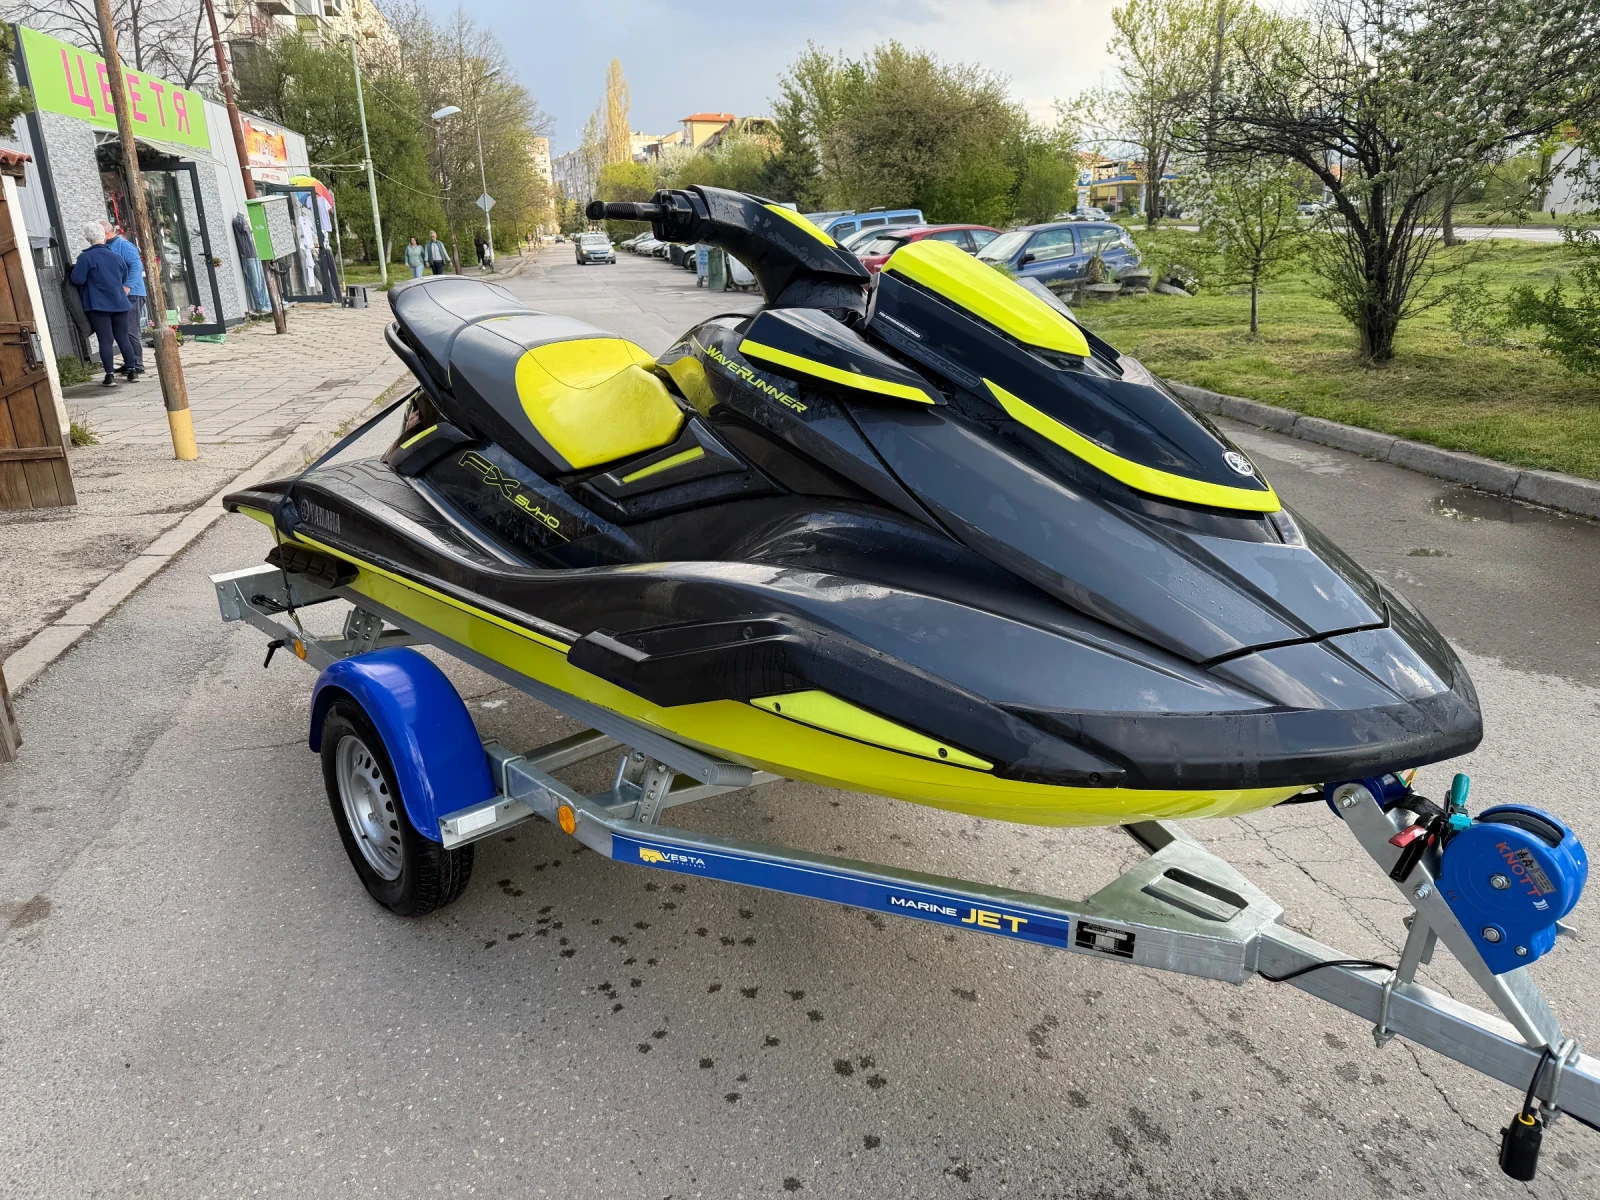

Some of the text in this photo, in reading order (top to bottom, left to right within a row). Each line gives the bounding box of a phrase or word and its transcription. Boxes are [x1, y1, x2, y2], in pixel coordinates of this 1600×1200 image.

[706, 345, 808, 413] WAVERUNNER
[459, 451, 521, 499] FX
[661, 852, 705, 866] VESTA
[1495, 841, 1542, 897] KNOTT
[891, 896, 1028, 933] MARINE JET
